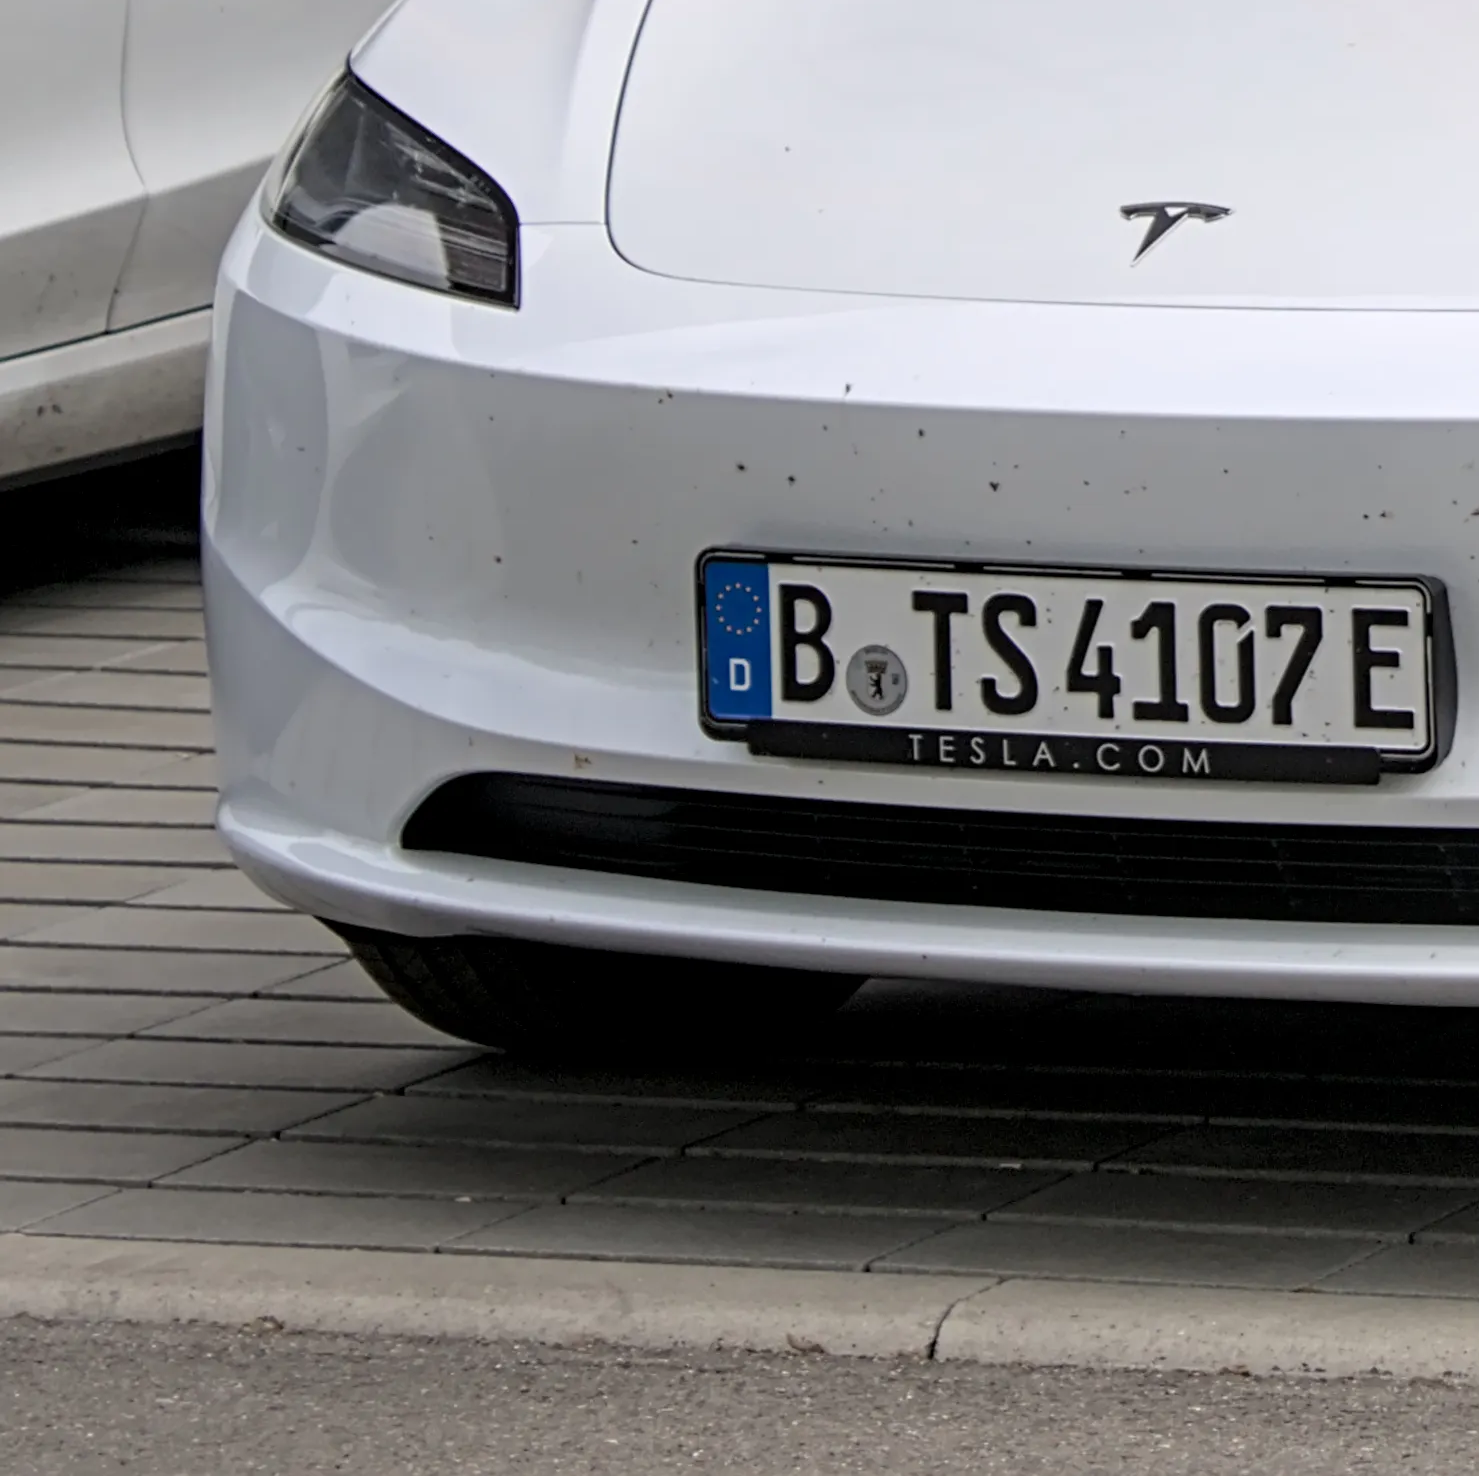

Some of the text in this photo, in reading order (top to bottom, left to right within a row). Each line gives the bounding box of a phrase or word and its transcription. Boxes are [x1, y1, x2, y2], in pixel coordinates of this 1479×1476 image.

[778, 584, 836, 702] B
[729, 658, 751, 691] D
[908, 733, 1212, 775] TESLA.COM
